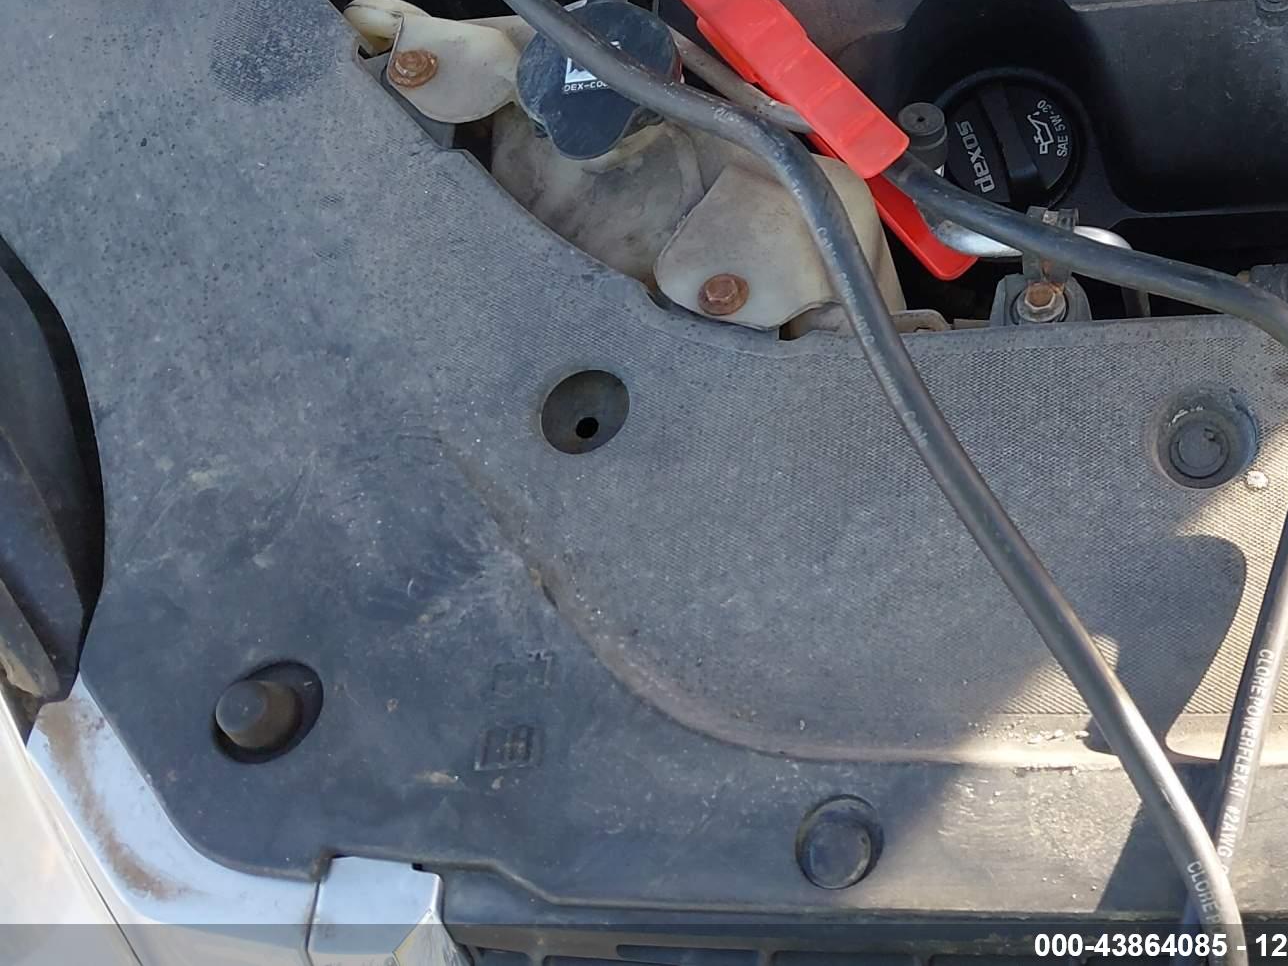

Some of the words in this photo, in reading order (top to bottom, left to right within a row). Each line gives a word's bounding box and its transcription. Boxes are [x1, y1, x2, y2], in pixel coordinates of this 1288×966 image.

[1036, 98, 1067, 132] 5W-30
[955, 120, 996, 193] dexos
[1056, 134, 1070, 158] SAE
[1250, 648, 1274, 695] CLORE
[1186, 861, 1218, 913] CLORE
